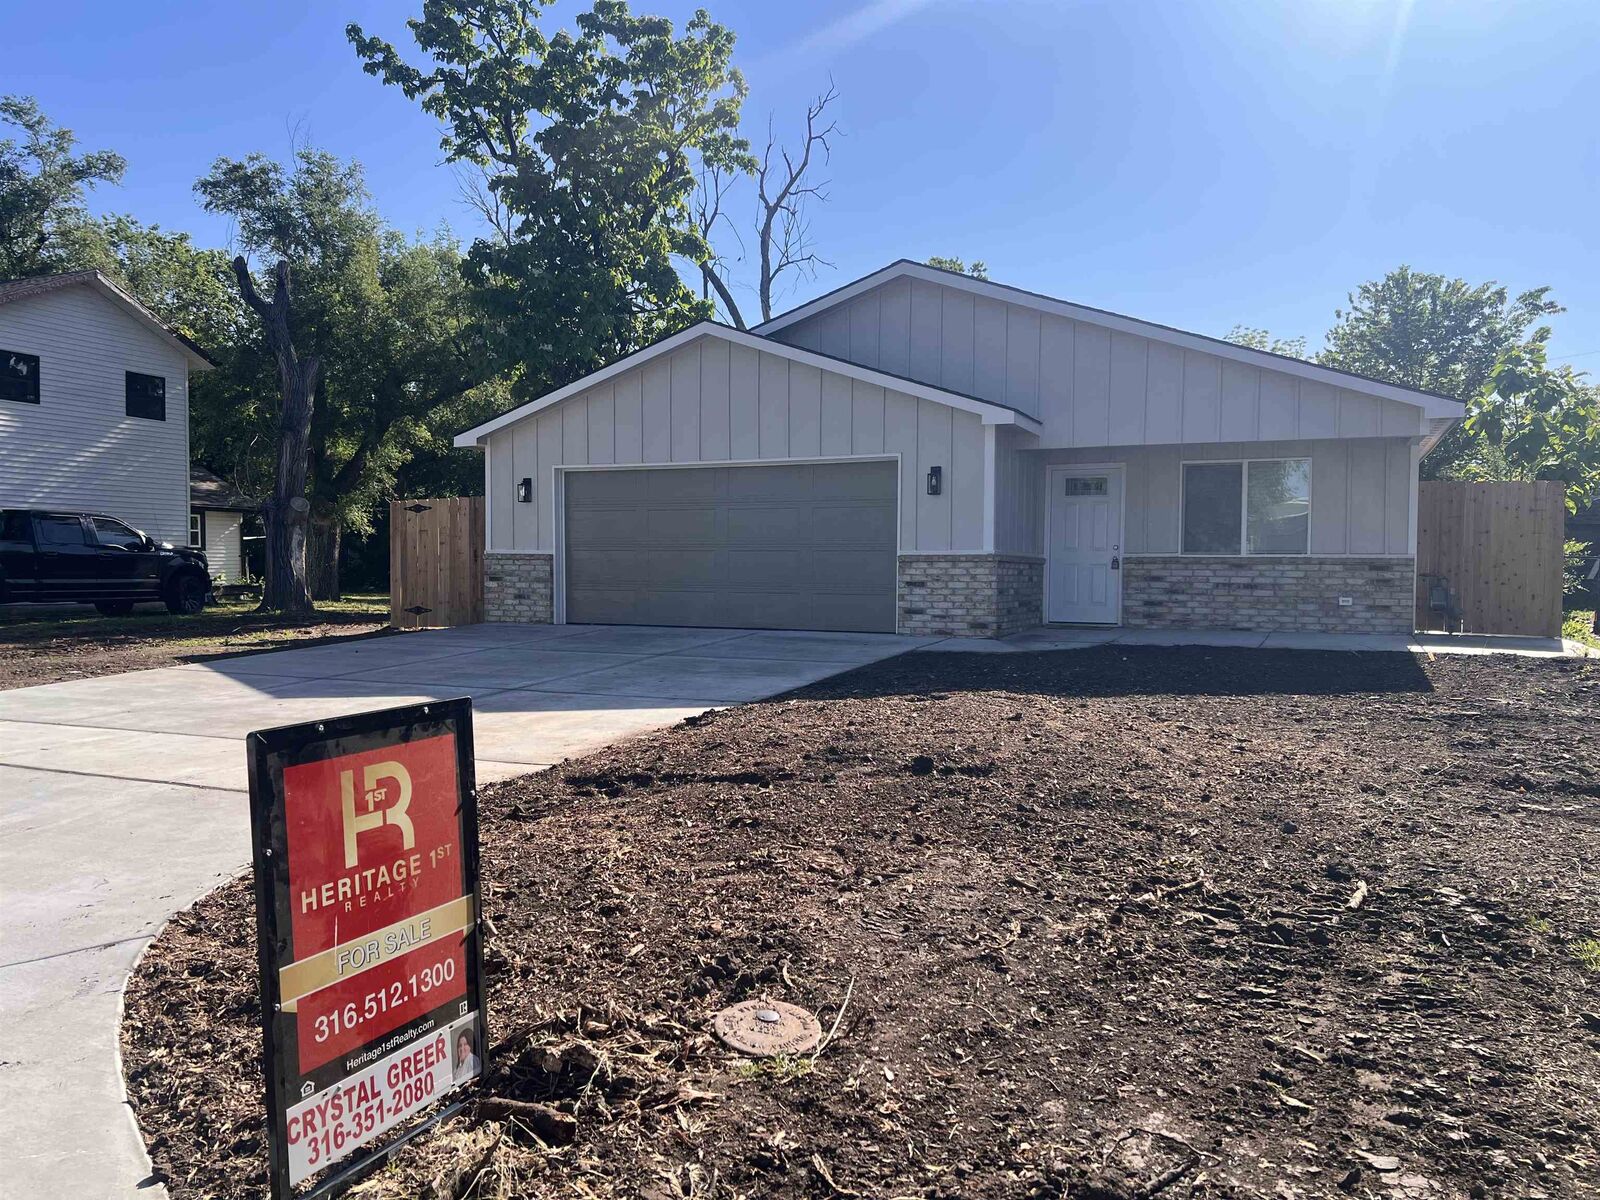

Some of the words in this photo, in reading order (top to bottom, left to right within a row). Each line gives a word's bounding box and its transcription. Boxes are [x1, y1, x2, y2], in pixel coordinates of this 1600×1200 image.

[301, 854, 421, 914] HERITAGE
[430, 844, 452, 868] 1ST
[344, 876, 420, 912] REALTY
[338, 940, 380, 975] FOR
[384, 918, 431, 954] SALE
[314, 958, 455, 1042] 316.512.1300
[346, 1018, 435, 1071] Heritage1stRealty.com
[287, 1075, 382, 1145] CRYSTAL
[386, 1035, 447, 1089] GREER
[308, 1072, 434, 1166] 316-351-2080
